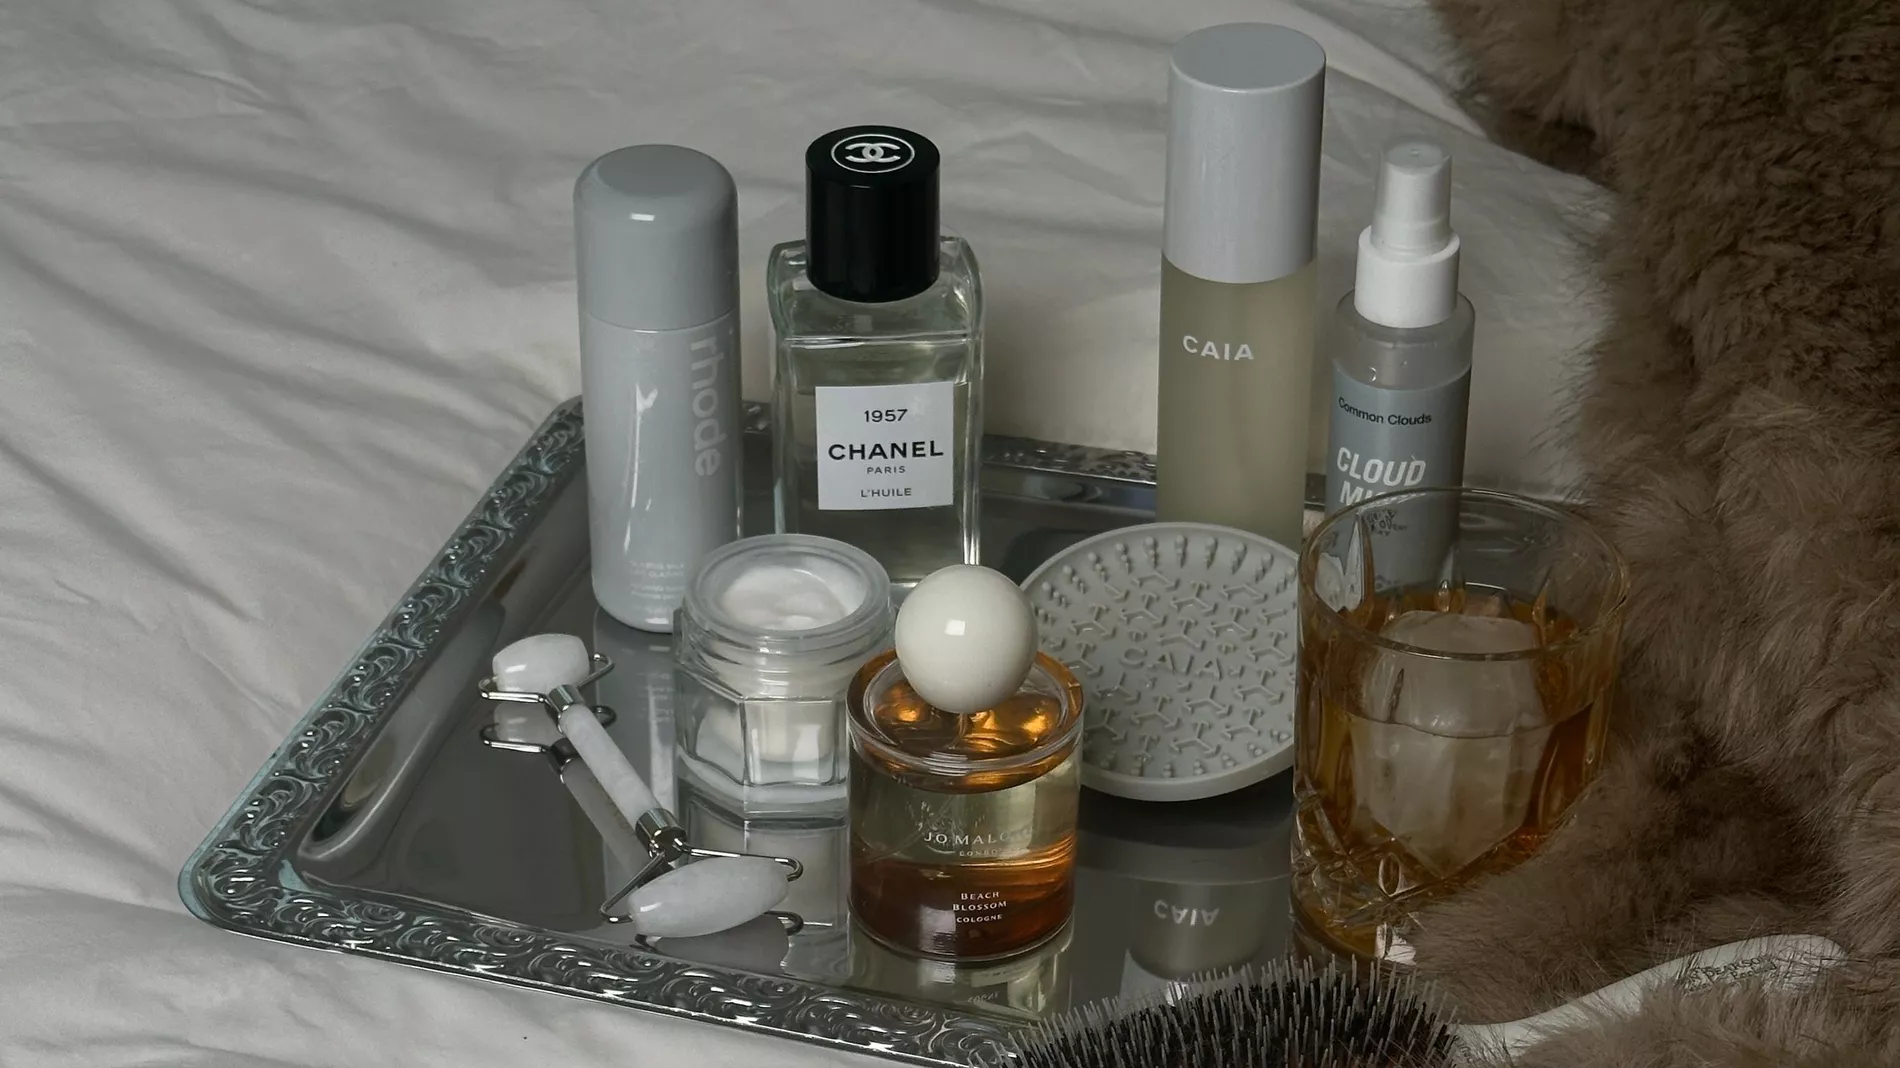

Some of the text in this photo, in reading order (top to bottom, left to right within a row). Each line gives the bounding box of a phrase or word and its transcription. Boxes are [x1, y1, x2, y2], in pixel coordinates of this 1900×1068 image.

[1182, 335, 1254, 361] CAIA
[691, 336, 728, 476] rhode
[1338, 397, 1433, 426] Common Clouds
[864, 408, 908, 423] 1957
[828, 440, 944, 461] CHANEL
[866, 465, 906, 475] PARIS
[1336, 446, 1427, 487] CLOUD
[860, 487, 912, 498] L'HUILE
[923, 832, 948, 844] JO
[960, 891, 1000, 901] BEACH
[952, 901, 1007, 912] BLOSSOM
[956, 914, 1002, 923] COLOGNE
